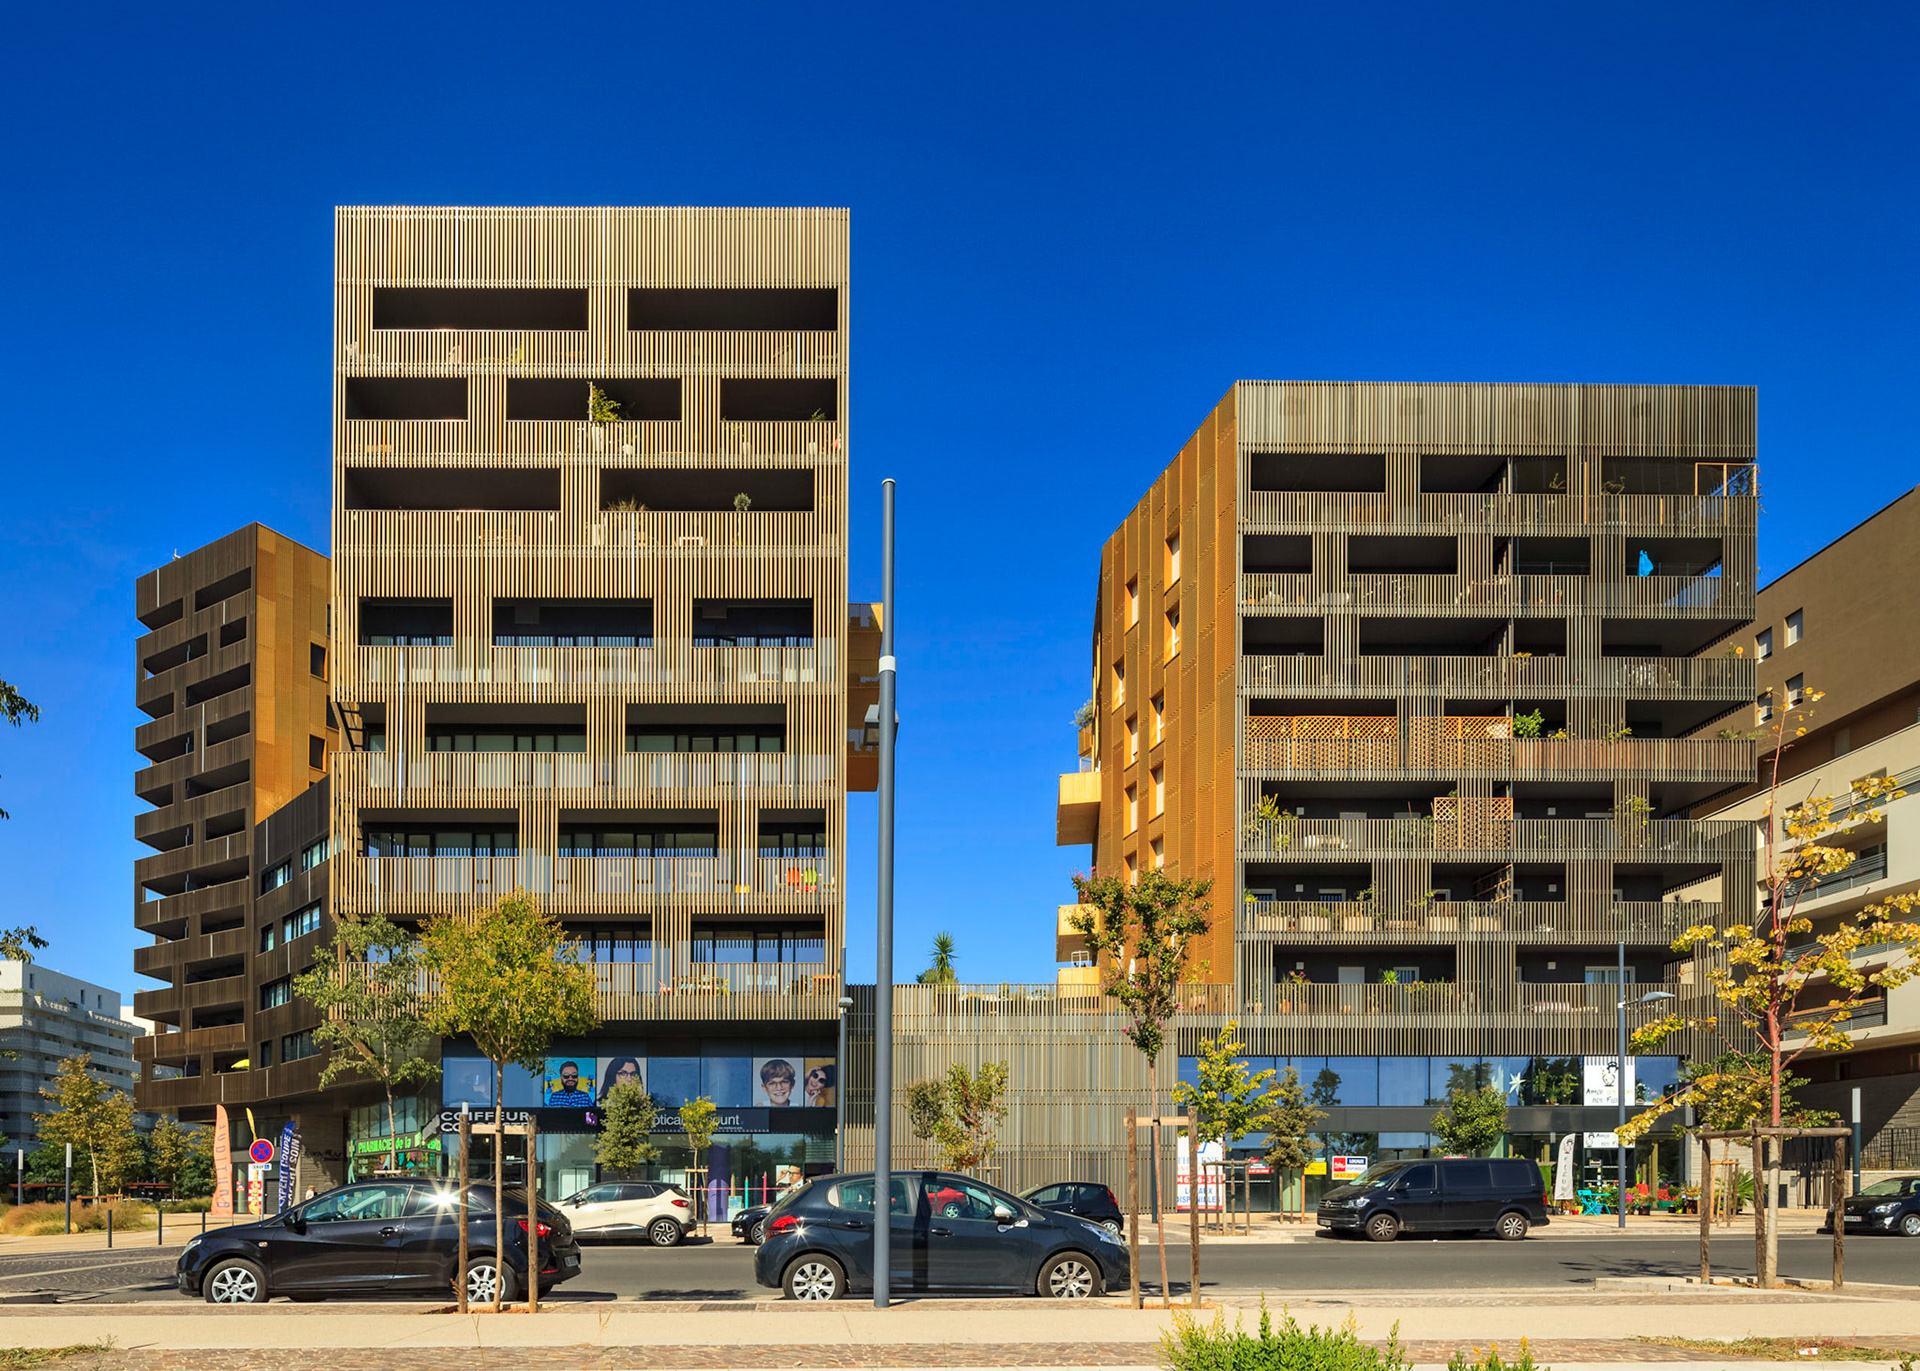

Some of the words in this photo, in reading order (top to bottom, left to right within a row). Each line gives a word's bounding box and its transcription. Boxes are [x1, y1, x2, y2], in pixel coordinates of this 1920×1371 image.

[441, 1112, 529, 1121] COIFFUR
[281, 1134, 291, 1168] COUPE
[290, 1138, 300, 1163] SOIN
[358, 1138, 392, 1154] PHARMACIE
[396, 1138, 403, 1150] de
[405, 1136, 411, 1149] la
